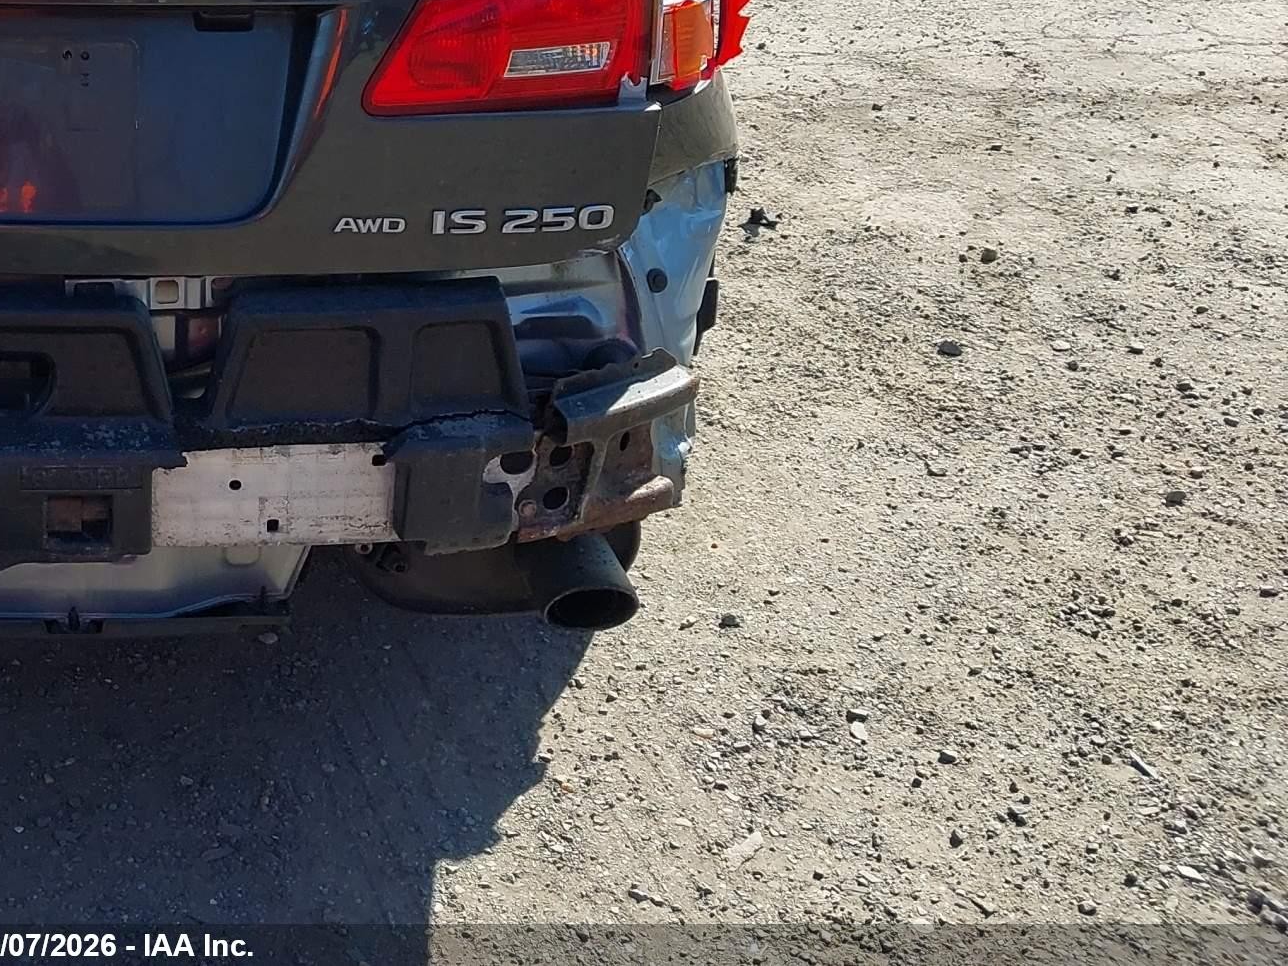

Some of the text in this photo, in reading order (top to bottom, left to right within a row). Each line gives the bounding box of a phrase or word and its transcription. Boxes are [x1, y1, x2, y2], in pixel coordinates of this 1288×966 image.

[333, 204, 615, 235] AWD IS 250
